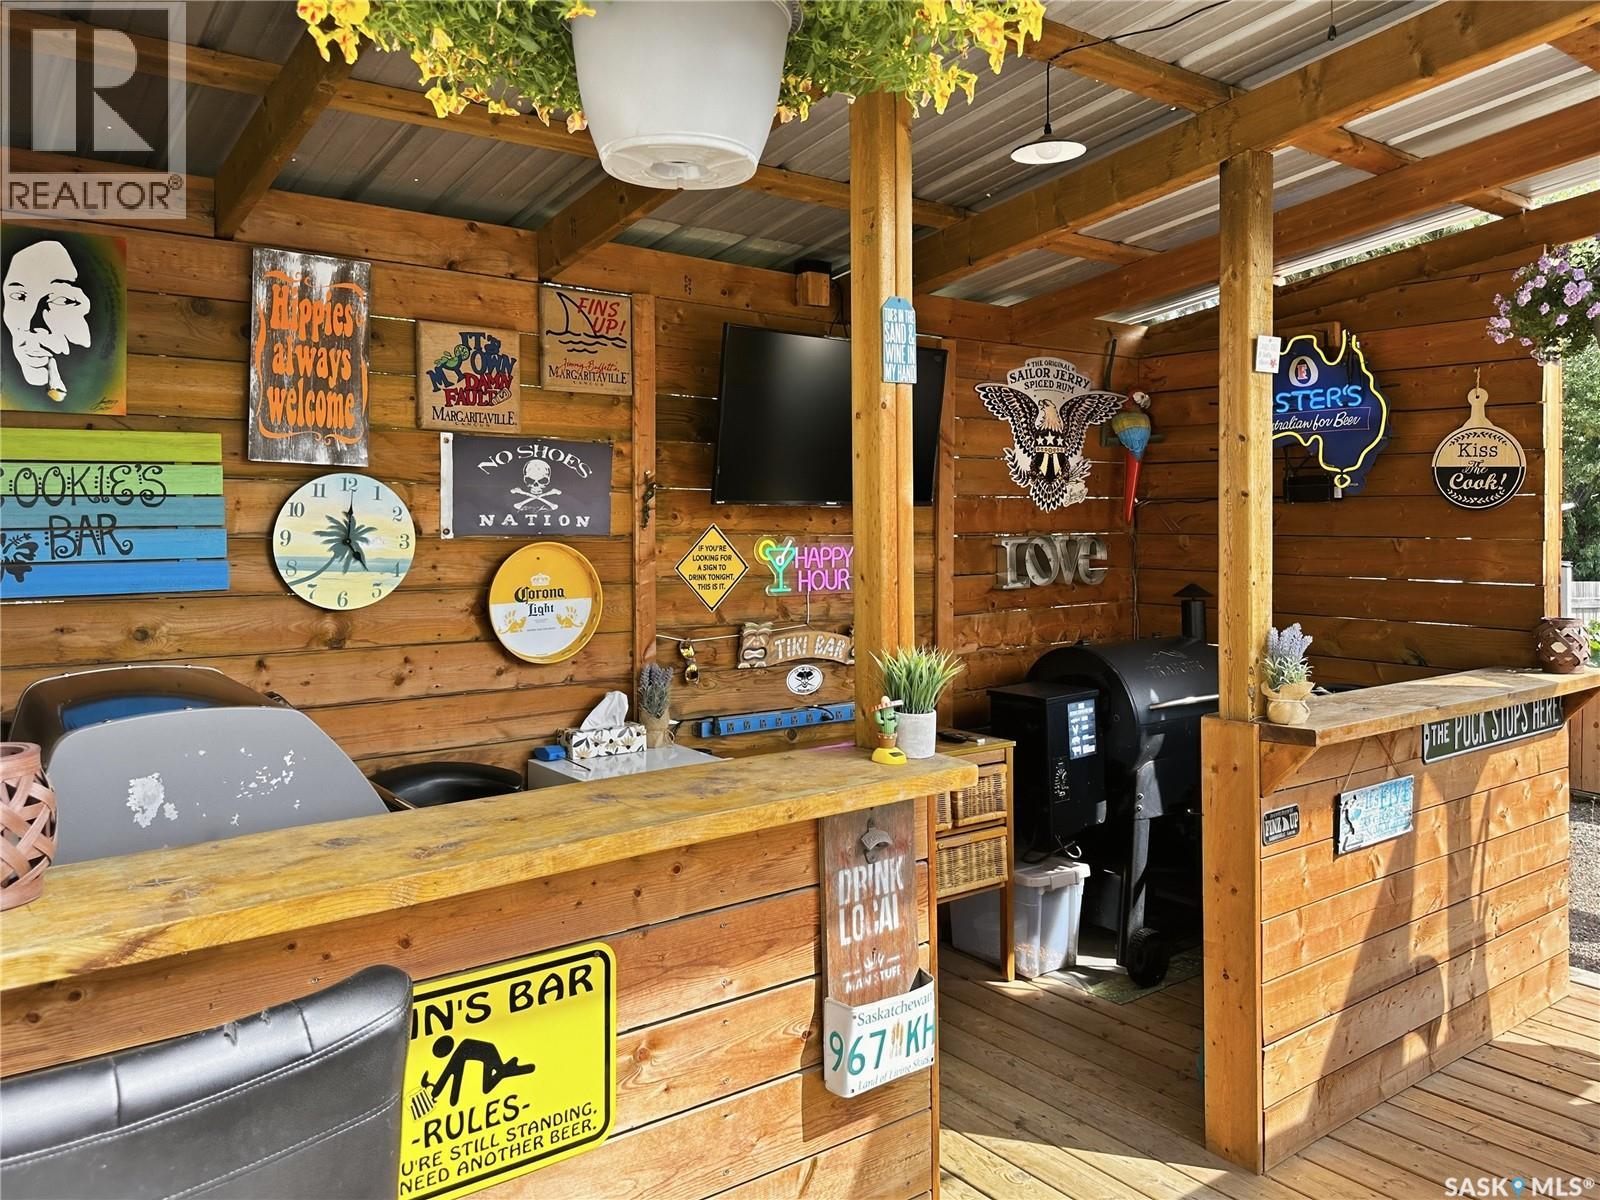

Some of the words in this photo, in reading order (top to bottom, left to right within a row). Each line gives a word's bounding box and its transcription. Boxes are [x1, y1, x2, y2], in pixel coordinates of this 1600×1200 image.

[270, 284, 354, 343] Hippies
[577, 297, 620, 317] FINS
[592, 317, 626, 336] UP!
[884, 322, 906, 344] SAND
[908, 324, 915, 344] &
[272, 334, 352, 388] always
[885, 343, 905, 364] WINE
[907, 344, 915, 365] IN
[426, 363, 465, 393] MY
[470, 349, 518, 376] OWN
[885, 363, 896, 381] MY
[1044, 360, 1071, 371] ORIGINAL
[464, 373, 514, 393] DAMN
[1009, 368, 1051, 385] SAILOR
[1052, 369, 1091, 389] JERRY
[1024, 379, 1054, 391] SPICED
[1056, 381, 1076, 394] RUM
[267, 378, 355, 430] welcome
[445, 389, 496, 407] FAULT
[432, 406, 514, 426] MARGARITAVILLE
[1273, 416, 1313, 431] tralian
[1312, 414, 1332, 431] for
[1332, 411, 1361, 428] Beer
[1457, 443, 1498, 458] Kiss
[477, 450, 513, 475] NO
[516, 444, 593, 479] SHOES
[1462, 460, 1488, 474] The
[0, 463, 167, 508] OOKIE'S
[311, 483, 326, 498] 11
[341, 477, 358, 492] 12
[1449, 472, 1507, 490] Cook!
[374, 486, 382, 500] 1
[288, 502, 305, 518] 10
[393, 505, 403, 522] 2
[479, 514, 590, 528] NATION
[49, 513, 133, 560] BAR
[280, 530, 291, 546] 9
[399, 534, 410, 549] 3
[794, 546, 853, 569] HAPPY
[285, 560, 297, 577] 8
[372, 583, 382, 598] 5
[798, 569, 850, 592] HOUR
[307, 584, 317, 600] 7
[337, 591, 348, 607] 6
[514, 585, 566, 605] Corona
[527, 603, 554, 617] Light
[774, 635, 808, 659] TIKI
[814, 635, 845, 659] BAR
[1431, 722, 1450, 746] THE
[1454, 711, 1487, 749] PUCK
[1491, 703, 1527, 741] STOPS
[1532, 696, 1559, 729] HERE
[838, 856, 904, 905] DRINK
[838, 893, 900, 946] LOCAL
[509, 964, 594, 1013] BAR
[857, 993, 933, 1027] Saskatchewan
[829, 1029, 887, 1076] 967
[858, 1077, 878, 1091] Land
[879, 1072, 889, 1082] of
[401, 1150, 442, 1176] U'RE
[450, 1132, 500, 1161] STILL
[506, 1102, 598, 1142] STANDING.
[400, 1167, 449, 1196] NEED
[457, 1135, 544, 1176] ANOTHER
[550, 1118, 597, 1144] BEER.
